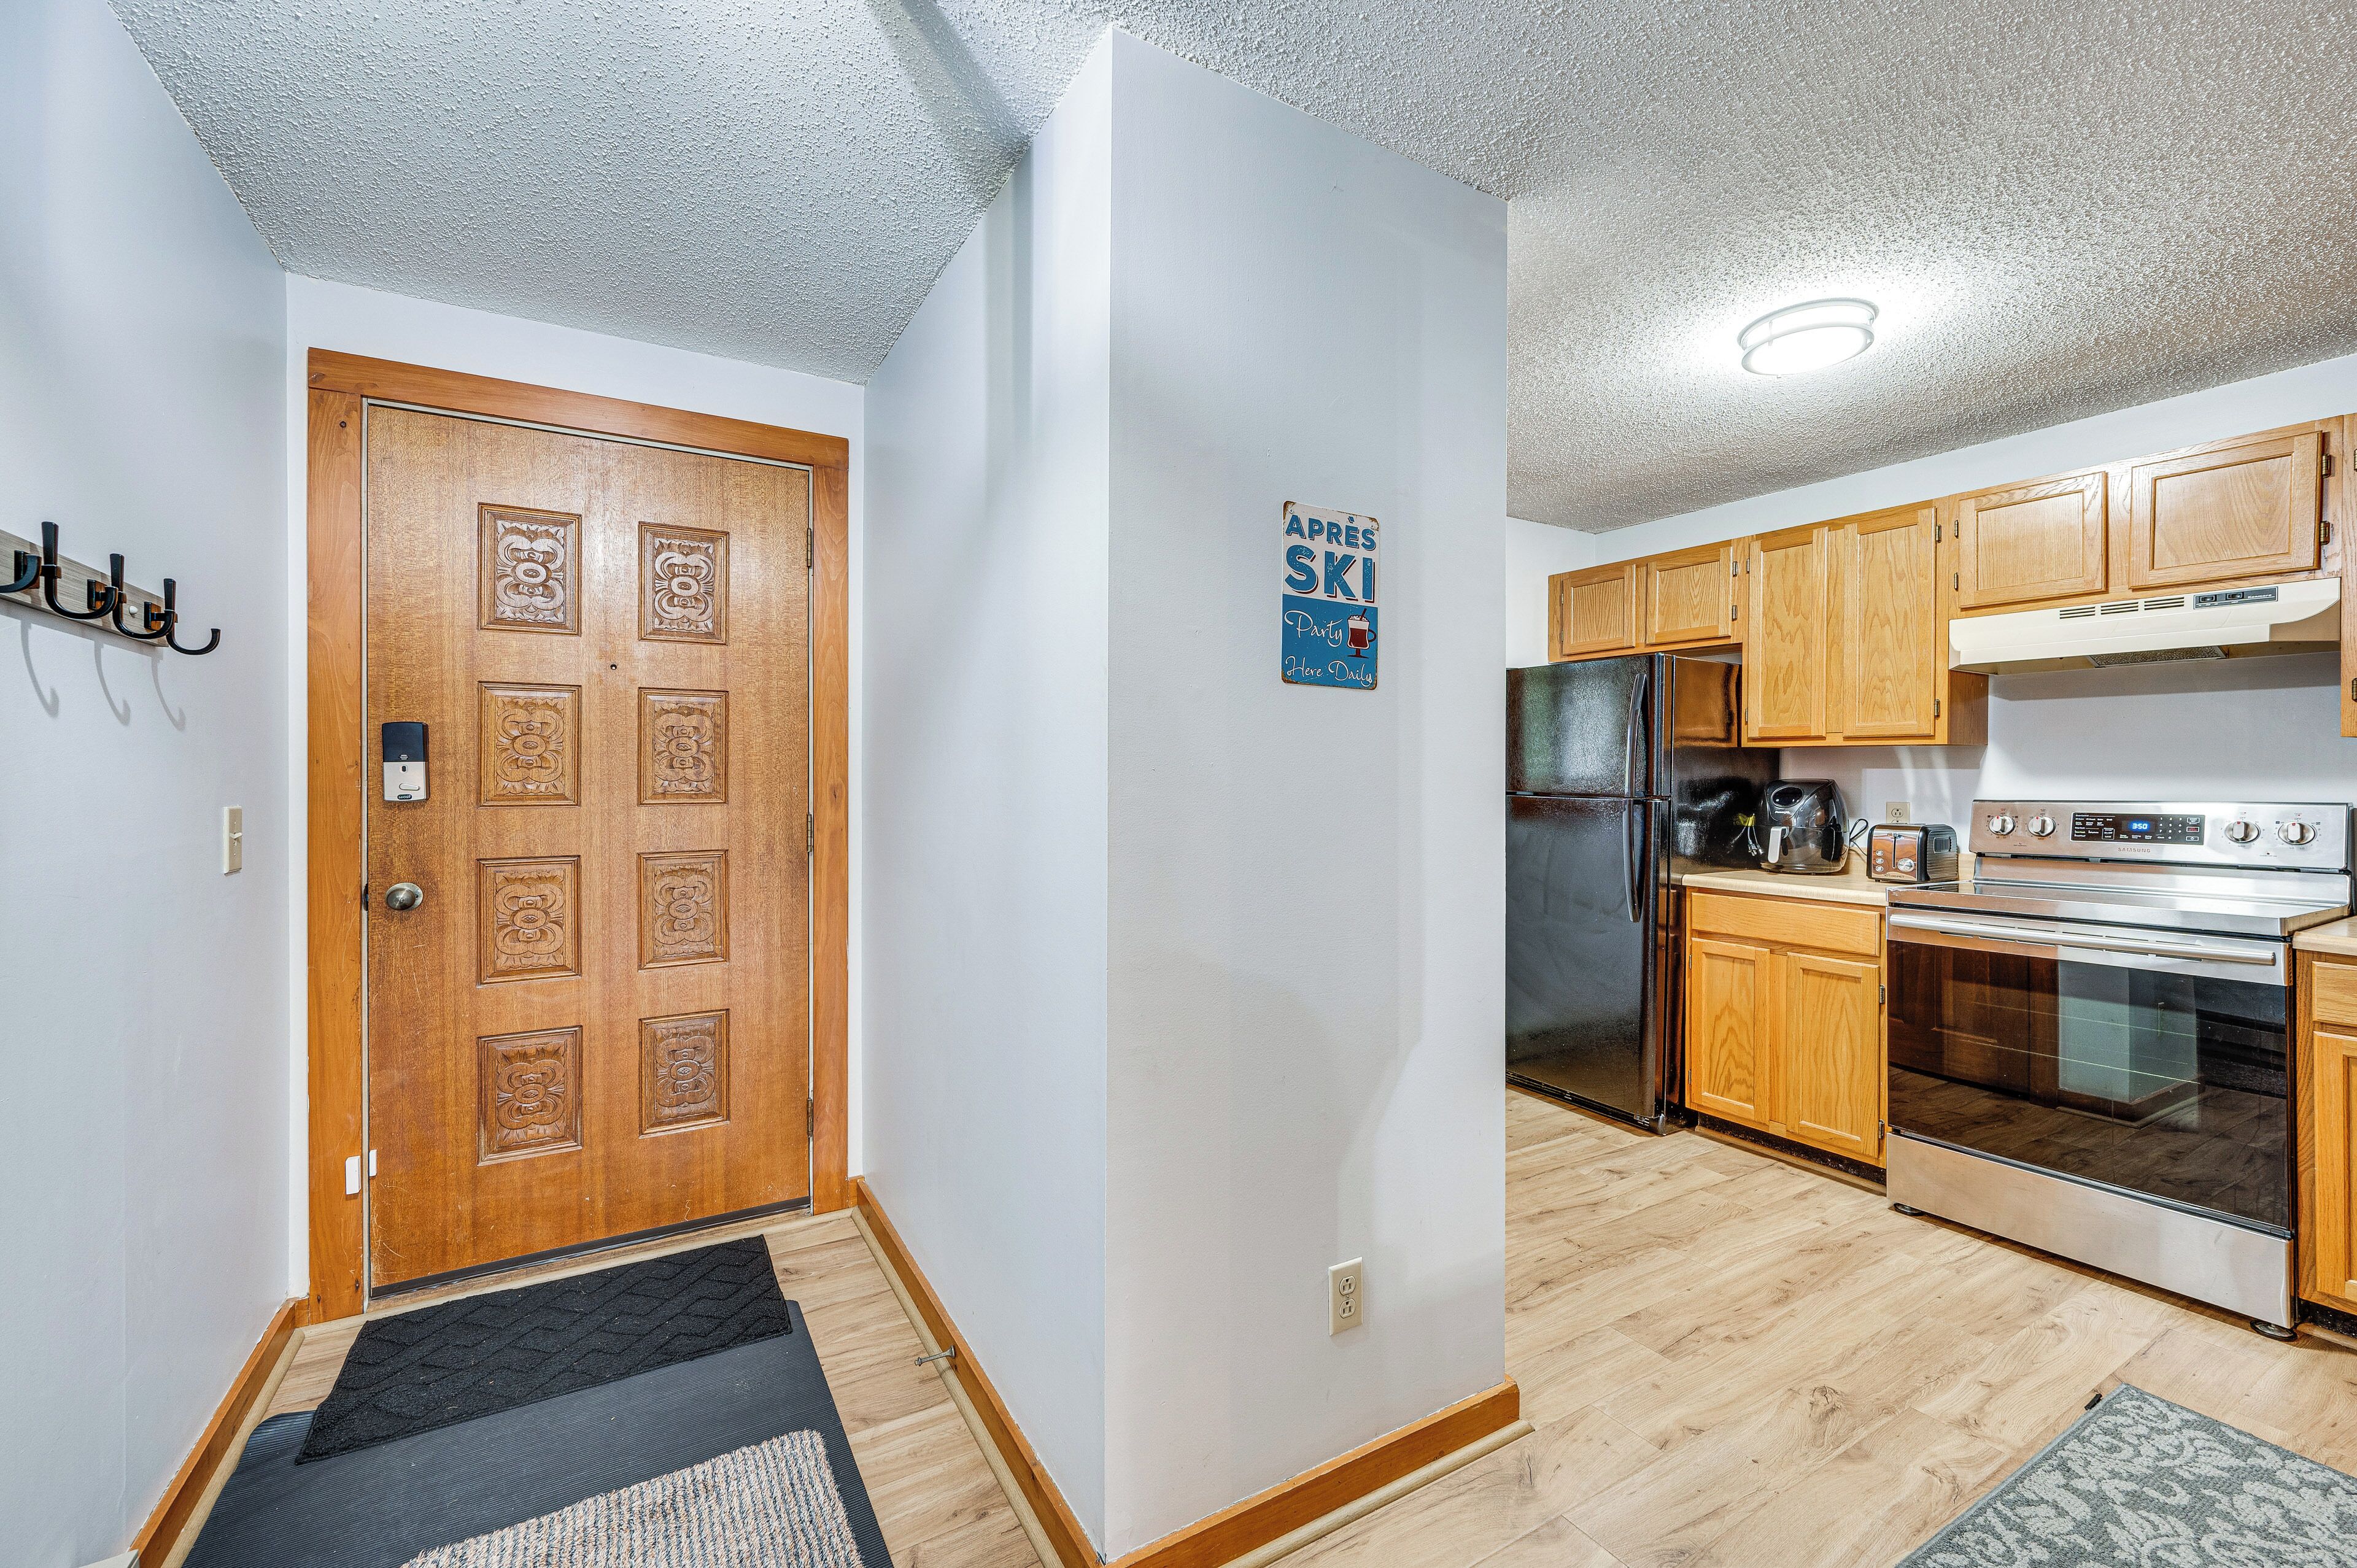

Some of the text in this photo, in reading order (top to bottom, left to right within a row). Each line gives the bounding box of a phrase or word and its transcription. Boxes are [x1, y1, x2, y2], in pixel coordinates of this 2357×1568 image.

[1285, 515, 1376, 551] APRÈS
[1285, 544, 1375, 603] SKI
[1284, 610, 1343, 647] Party
[1285, 656, 1372, 687] Here Daily
